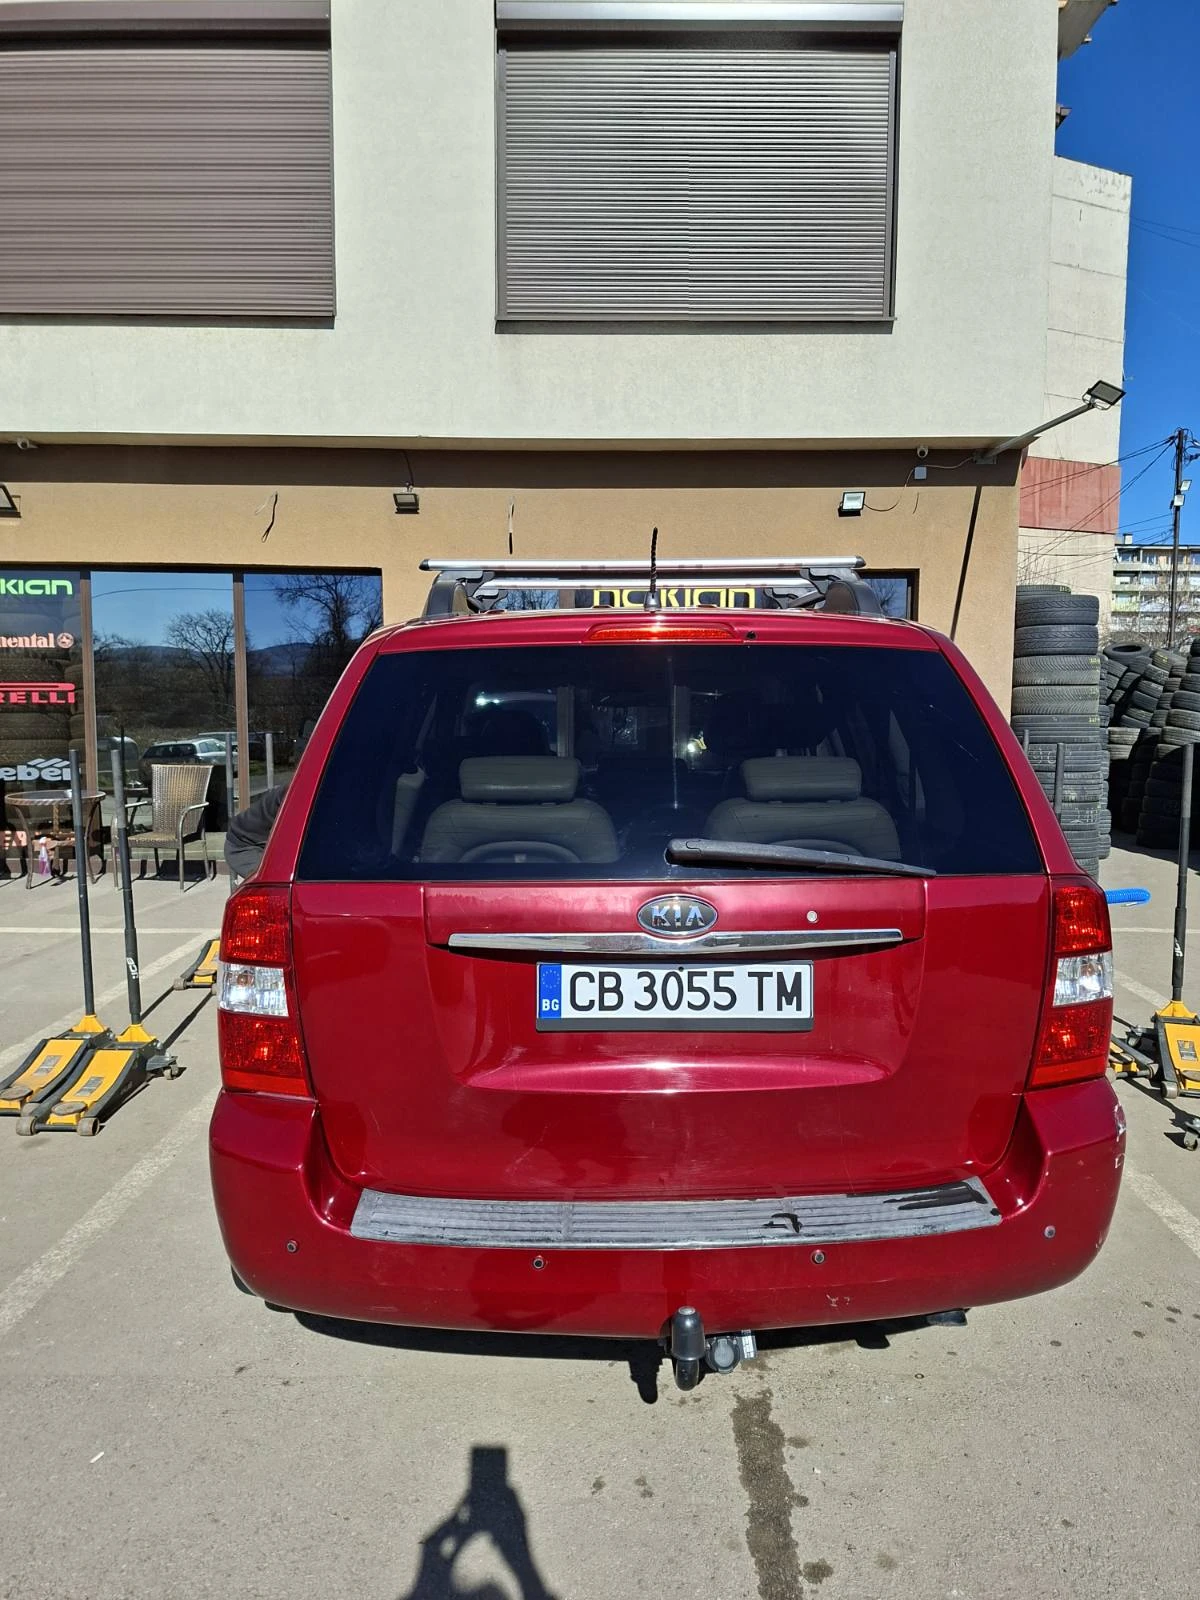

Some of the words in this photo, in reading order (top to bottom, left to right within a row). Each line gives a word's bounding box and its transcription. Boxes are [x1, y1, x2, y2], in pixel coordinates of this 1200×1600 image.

[0, 691, 75, 704] ELLI
[651, 904, 705, 928] KIA
[569, 971, 624, 1012] CB
[634, 971, 737, 1011] 3055
[748, 971, 803, 1012] TM
[542, 999, 560, 1012] BG
